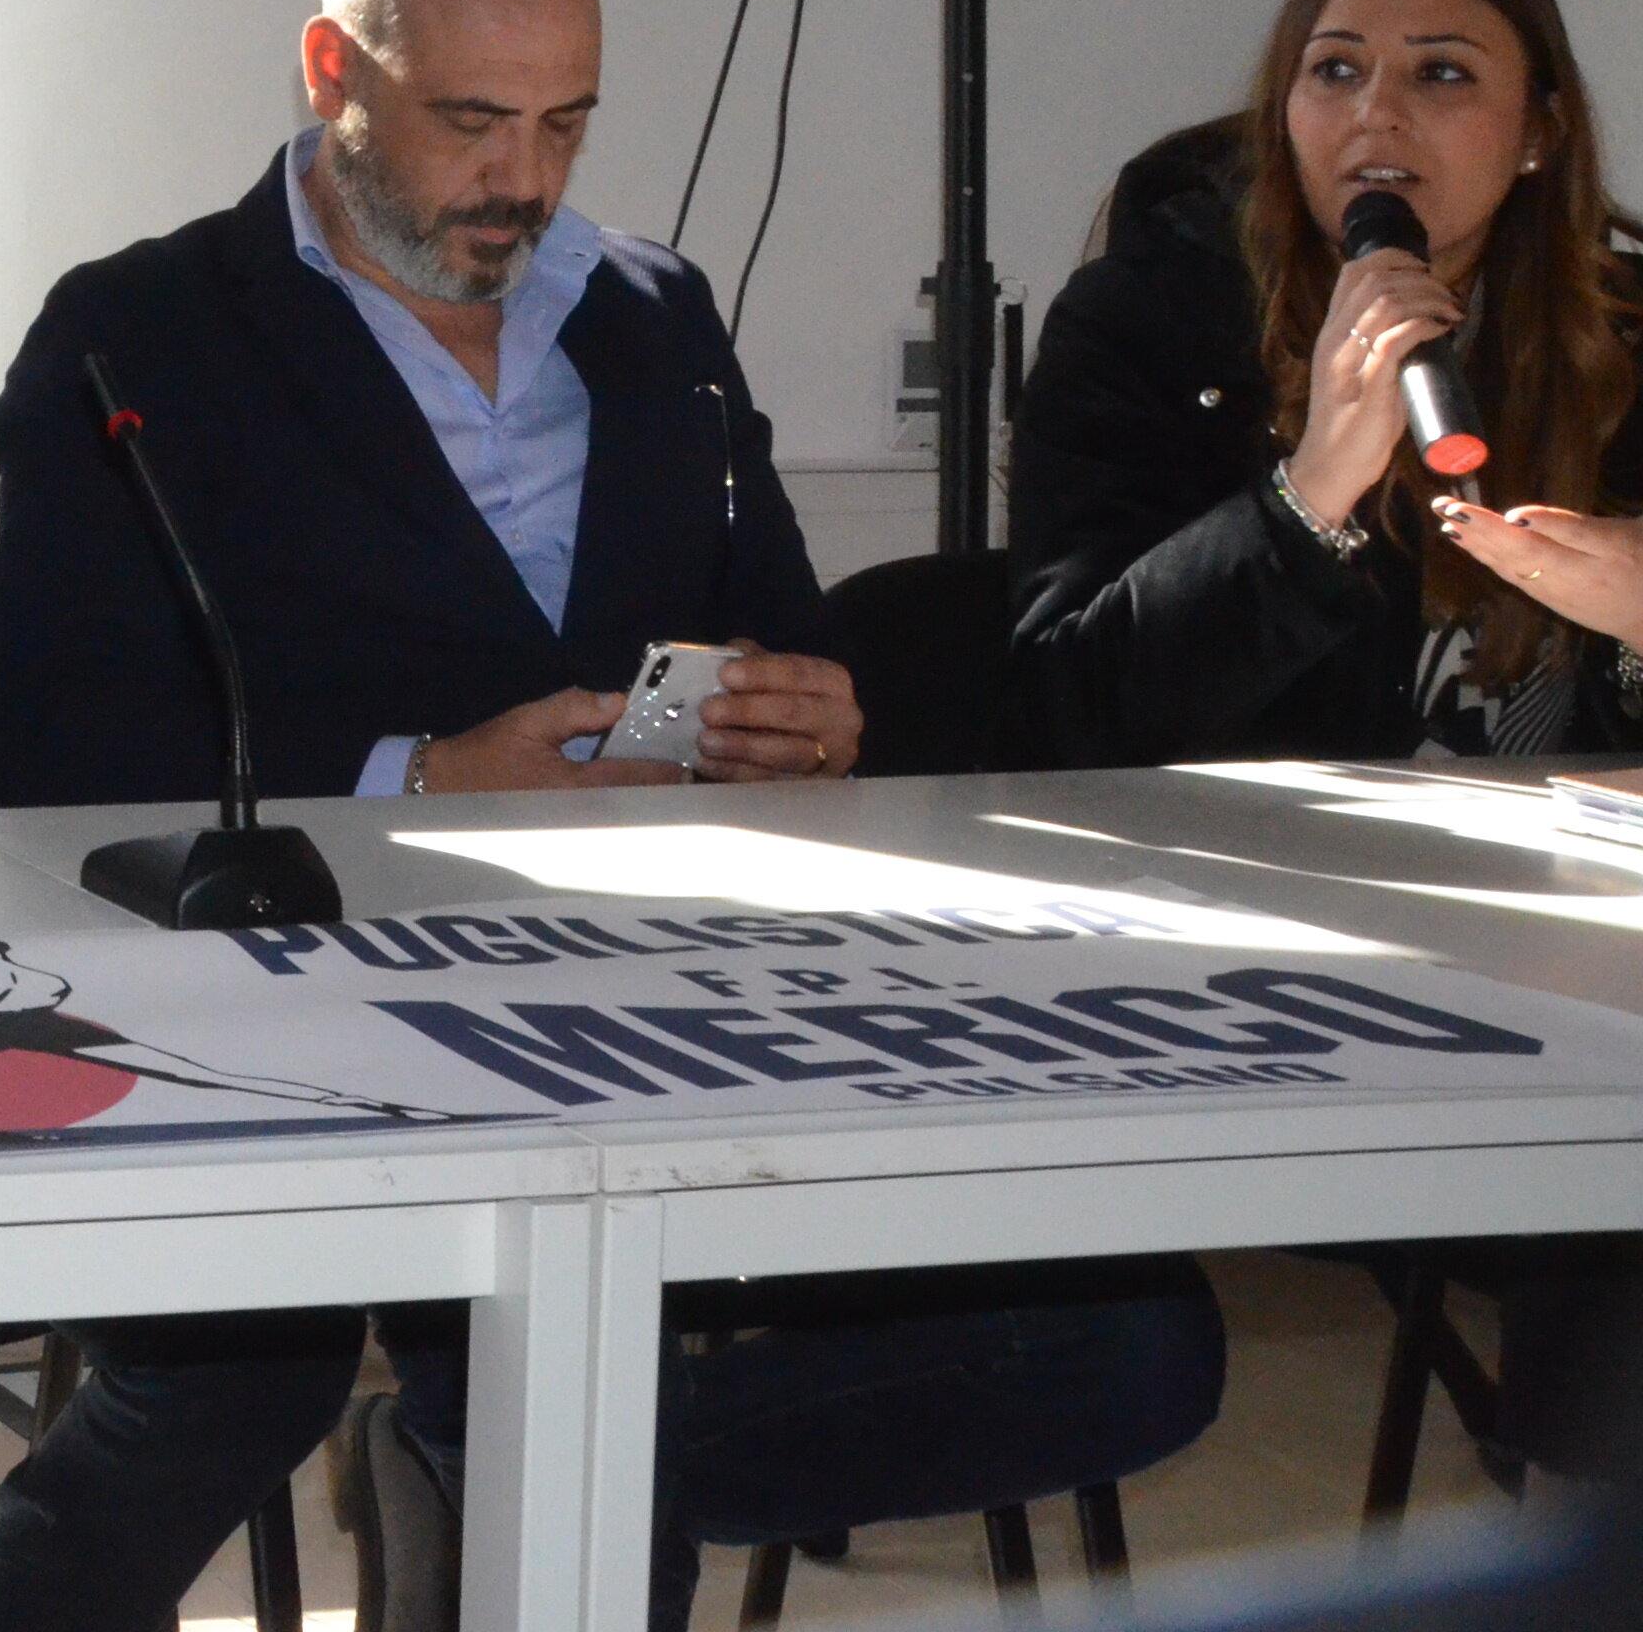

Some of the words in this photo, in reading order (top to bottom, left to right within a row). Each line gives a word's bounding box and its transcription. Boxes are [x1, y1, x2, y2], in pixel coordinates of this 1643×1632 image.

[215, 901, 1187, 975] PUGILISTICA
[361, 968, 1544, 1106] MERICO
[846, 1062, 1349, 1101] PULSANO
